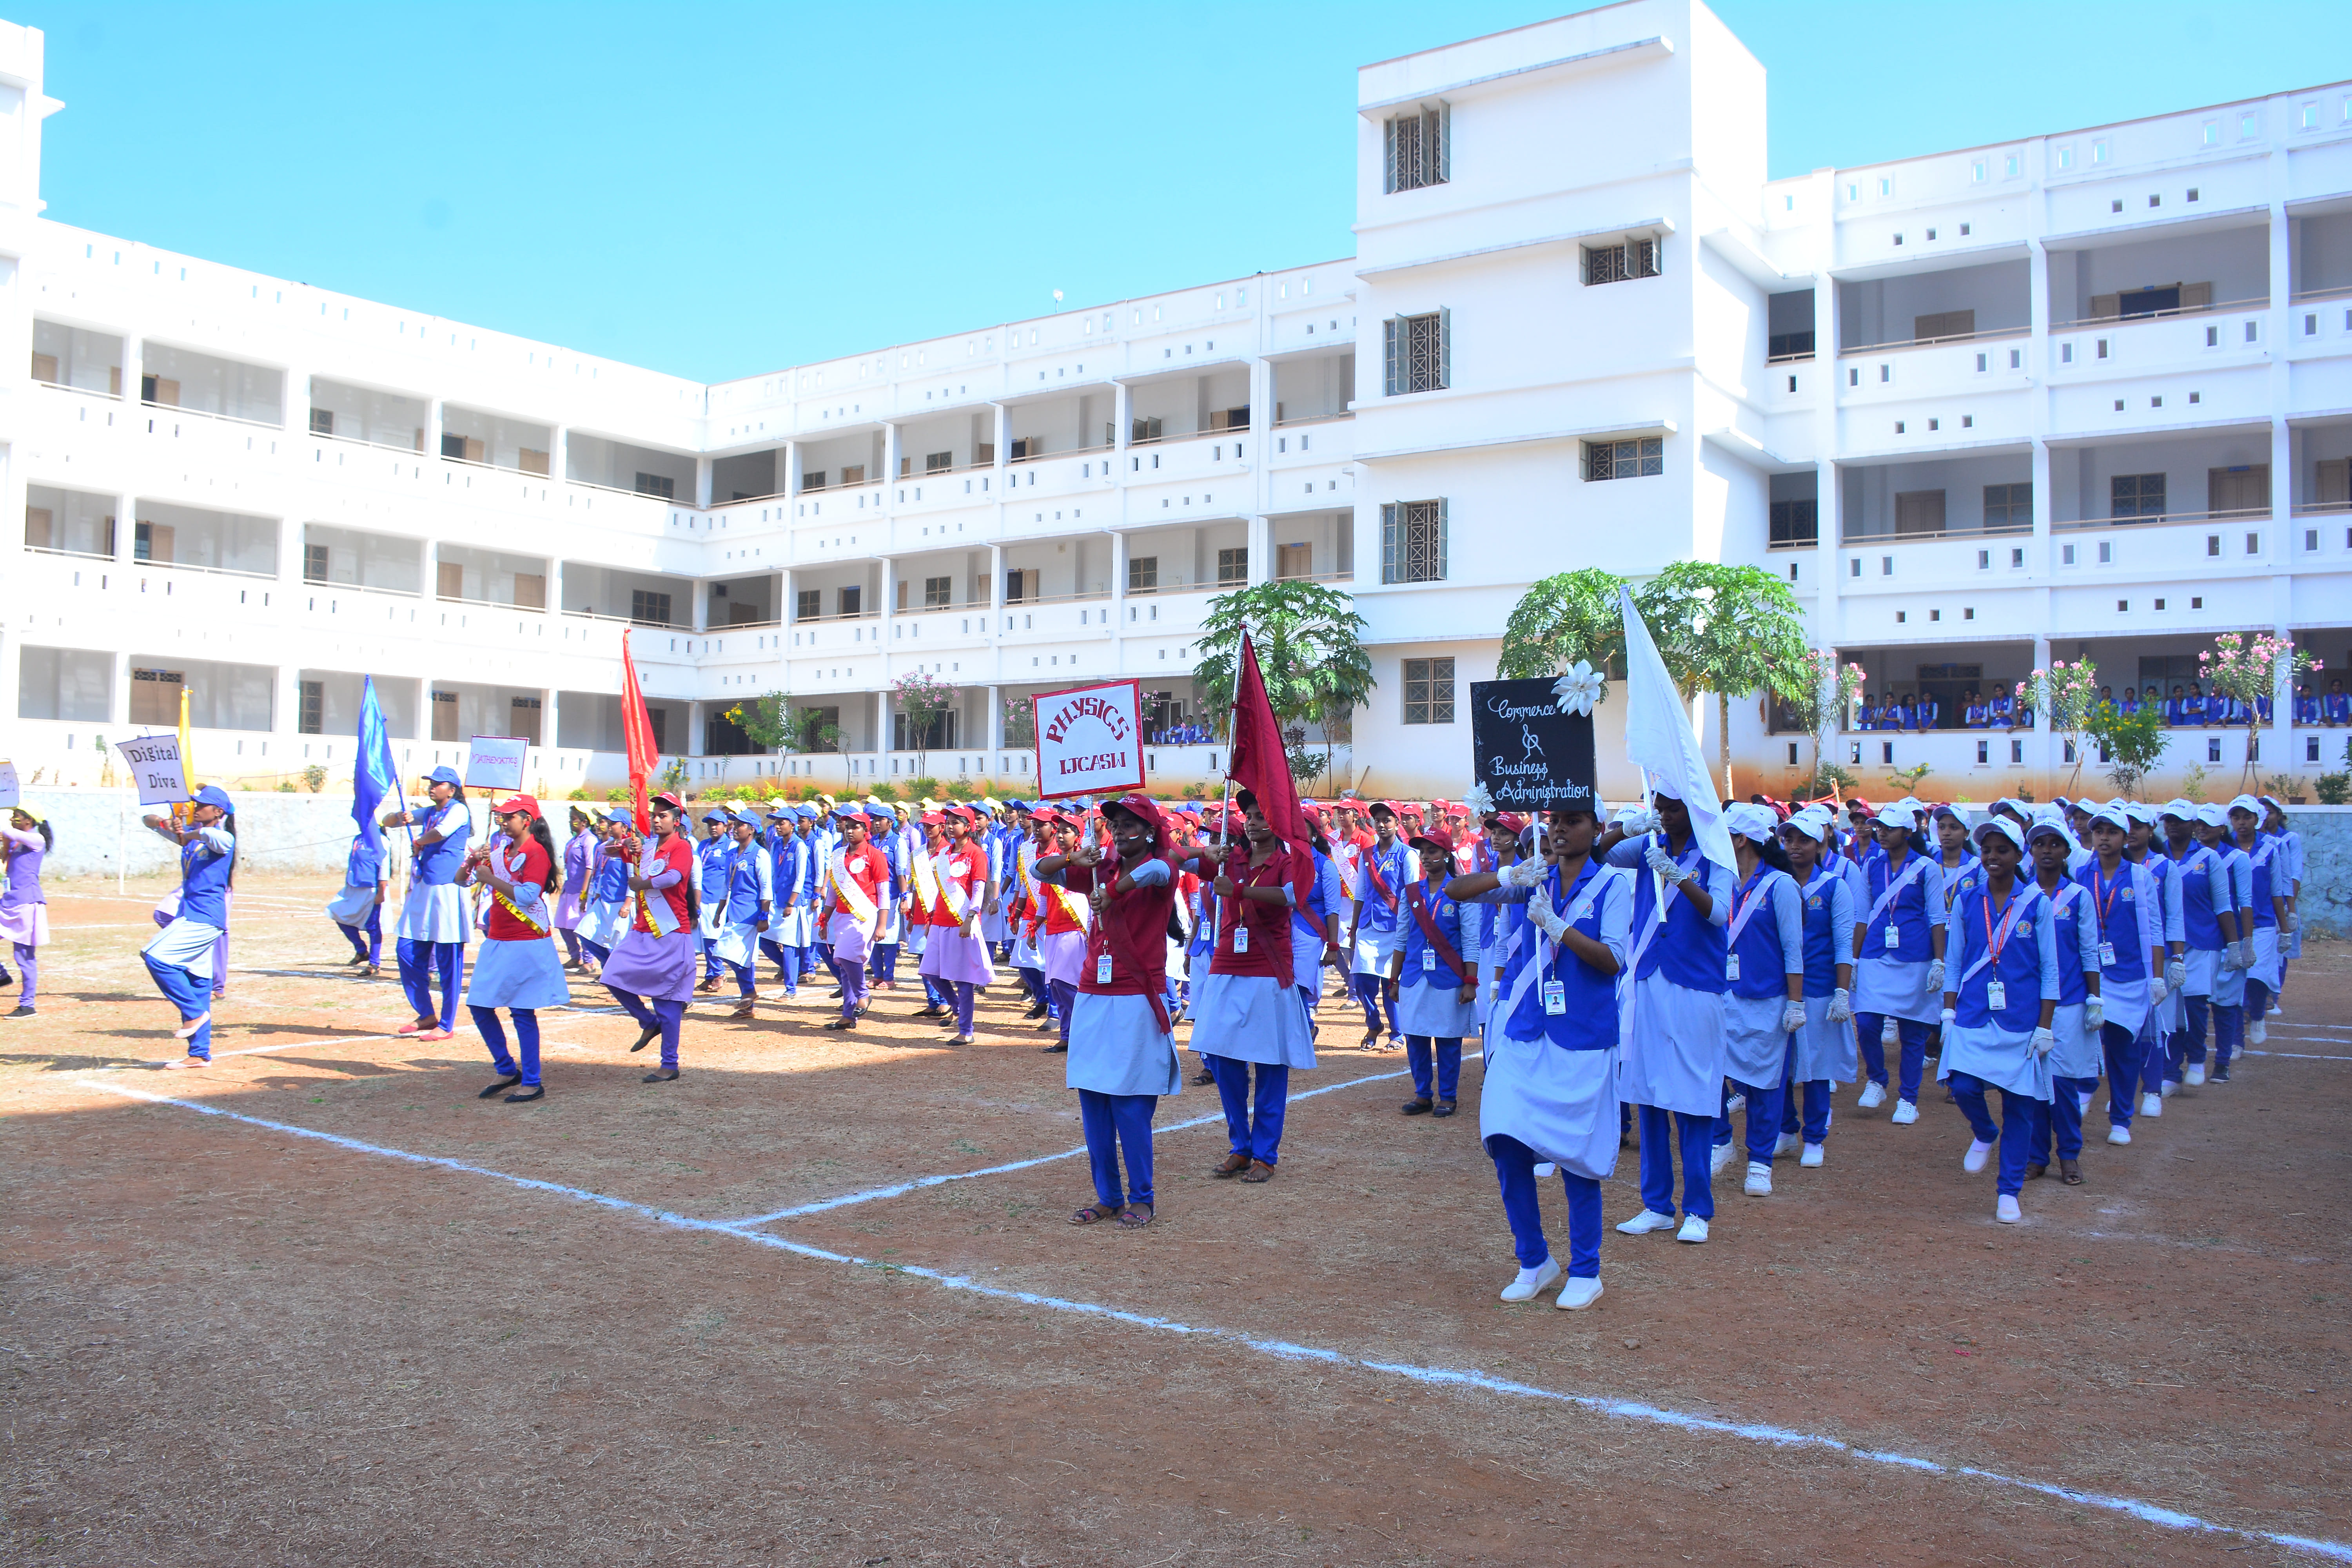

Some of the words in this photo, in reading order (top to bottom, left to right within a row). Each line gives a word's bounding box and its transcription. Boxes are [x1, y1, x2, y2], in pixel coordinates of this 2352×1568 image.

[1046, 697, 1130, 744] PHYSICS
[1488, 695, 1557, 723] Commerce
[128, 745, 178, 762] Digital
[1522, 724, 1546, 761] &
[470, 753, 518, 767] MATHEMATICS
[1060, 752, 1126, 775] IJCASW
[1488, 756, 1548, 780] Business
[148, 772, 177, 788] Diva
[1495, 777, 1590, 808] Administration
